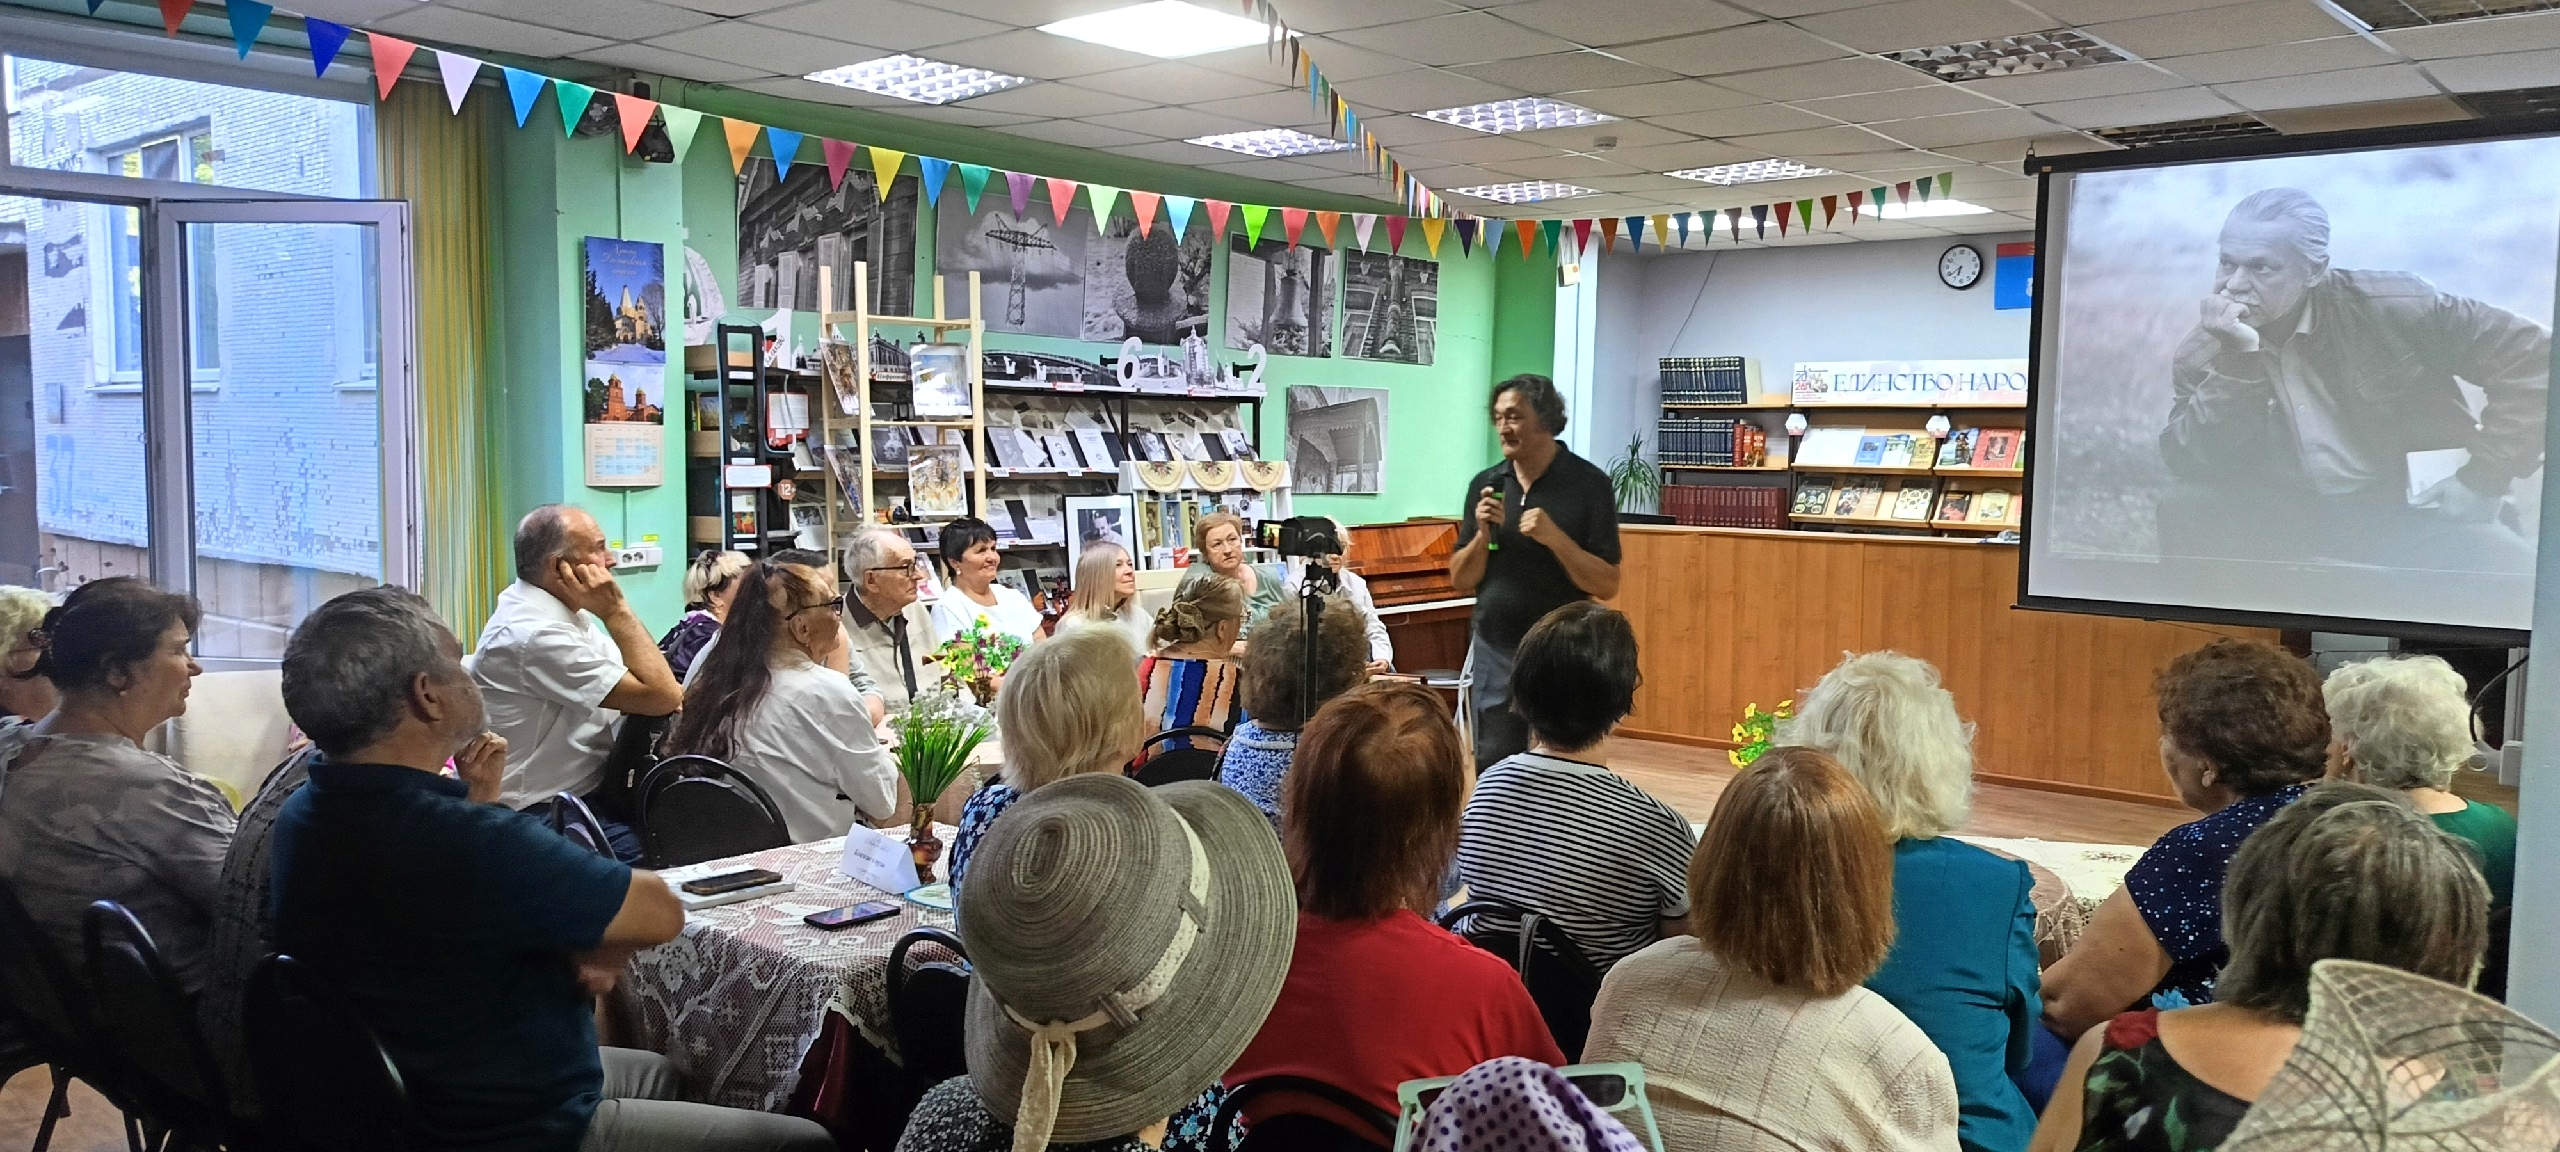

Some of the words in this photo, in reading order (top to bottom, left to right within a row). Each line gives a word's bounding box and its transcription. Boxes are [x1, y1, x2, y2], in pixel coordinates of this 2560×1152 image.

[761, 307, 792, 369] 1
[1117, 336, 1143, 387] 6
[1247, 343, 1267, 392] 2
[1833, 372, 1954, 392] ЕДИНСТВО
[1959, 372, 2028, 392] НАРО
[781, 483, 797, 496] 12+
